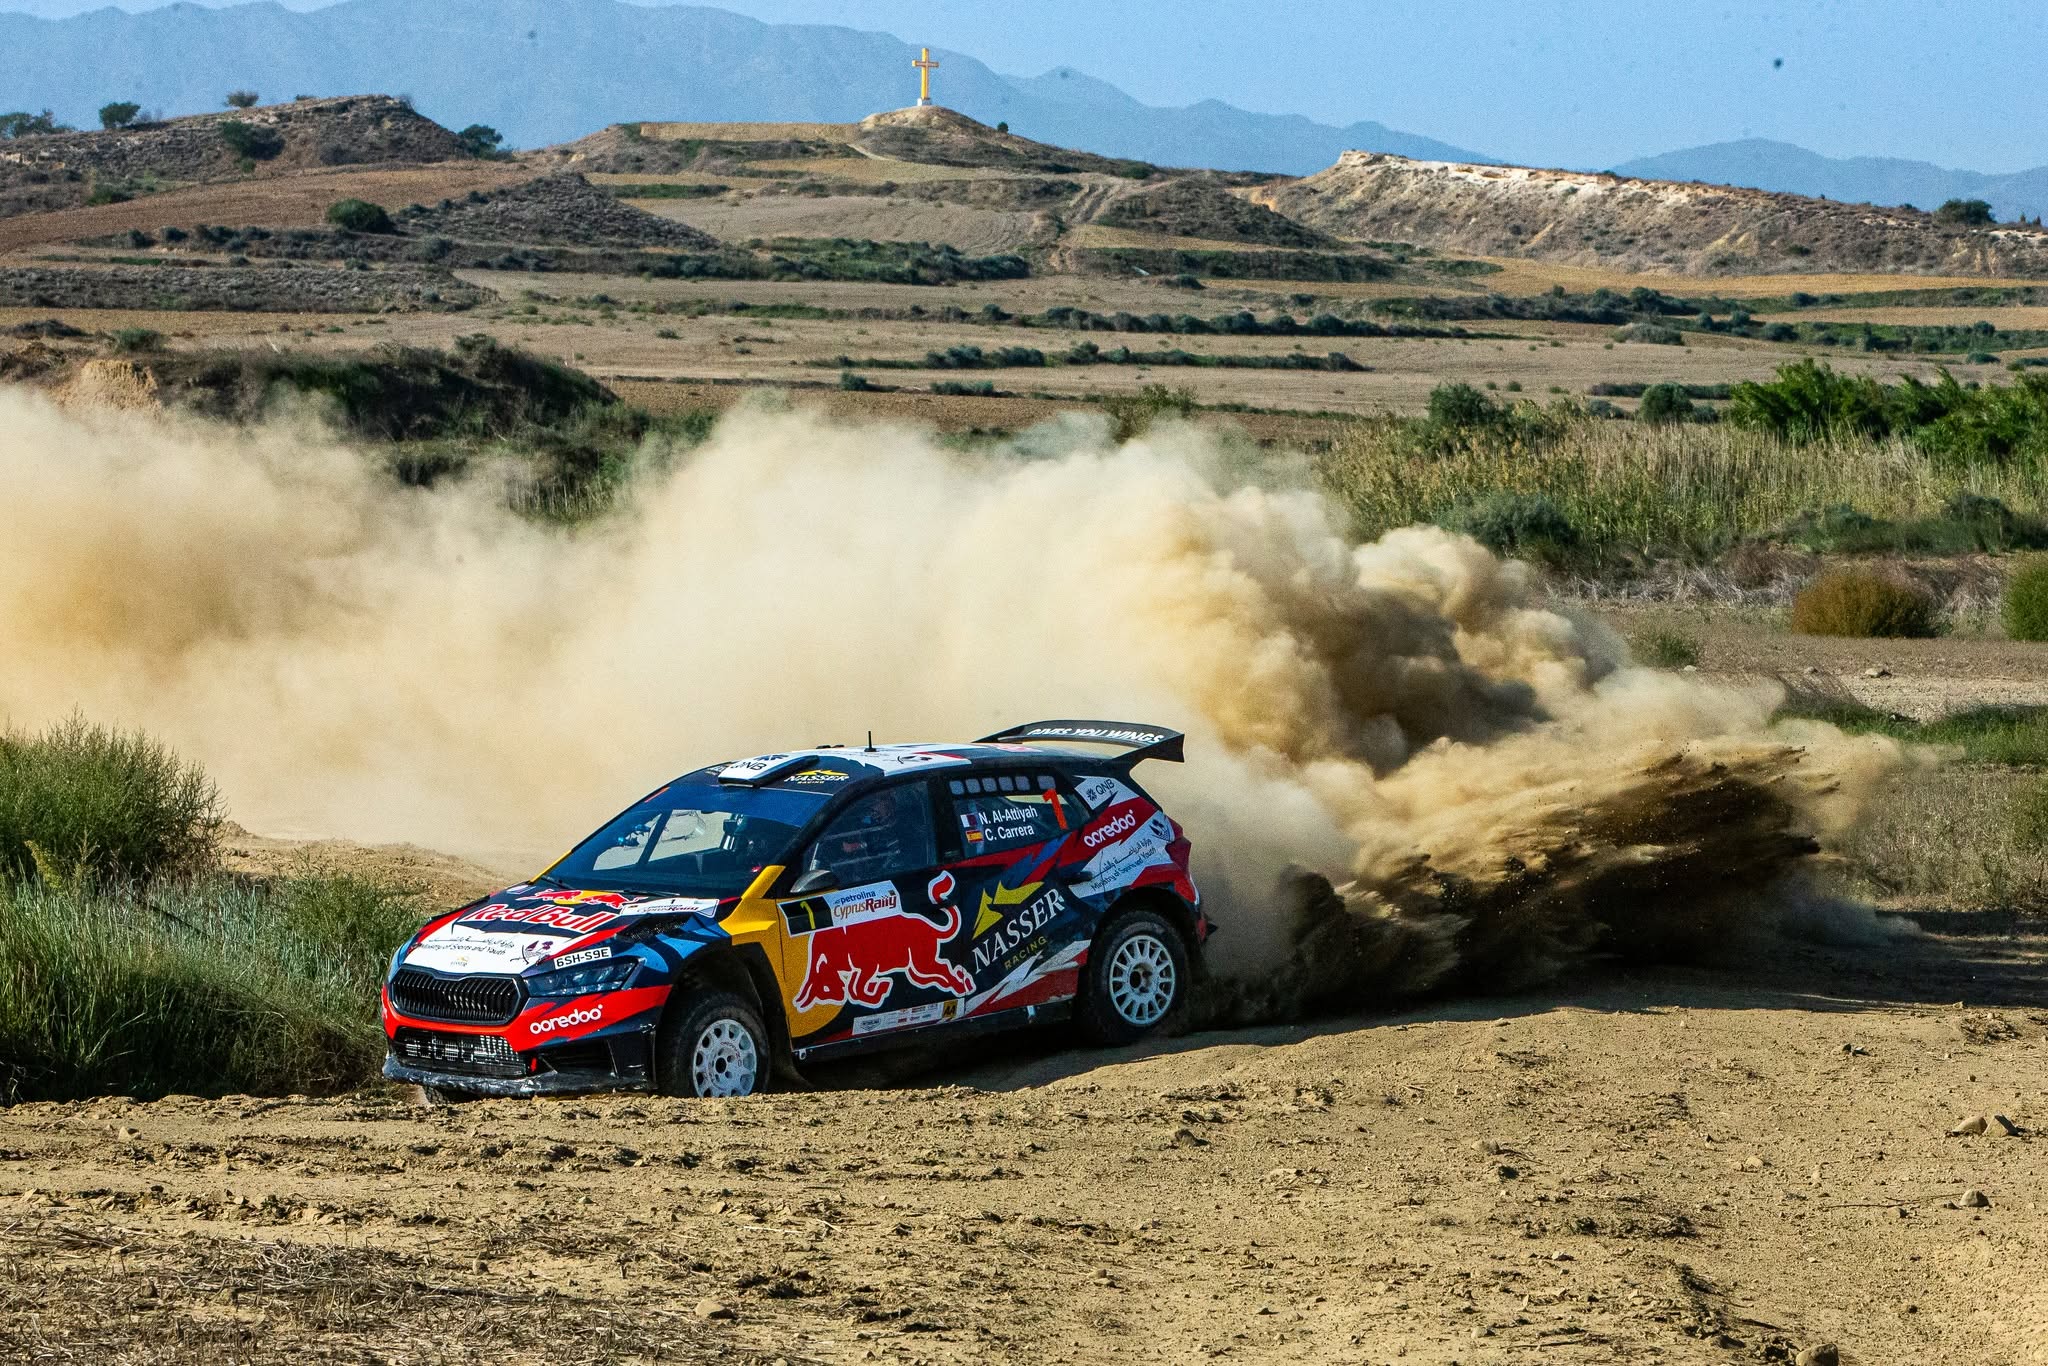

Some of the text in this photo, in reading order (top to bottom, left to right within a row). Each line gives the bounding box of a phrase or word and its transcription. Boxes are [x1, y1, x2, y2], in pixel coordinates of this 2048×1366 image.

[1071, 728, 1108, 737] YOU
[1105, 730, 1166, 745] WINGS
[1095, 779, 1115, 796] QNB
[978, 805, 1038, 825] N. Al-Attiyah
[1042, 788, 1068, 830] 1
[985, 825, 1035, 841] C. Carrera
[1083, 809, 1136, 848] ooredoo
[840, 890, 877, 906] petrolina
[800, 901, 816, 930] 1
[971, 888, 1066, 975] NASSER
[555, 948, 611, 968] 6SH-S9E
[1004, 936, 1048, 970] RACING
[529, 1004, 604, 1035] ooredoo
